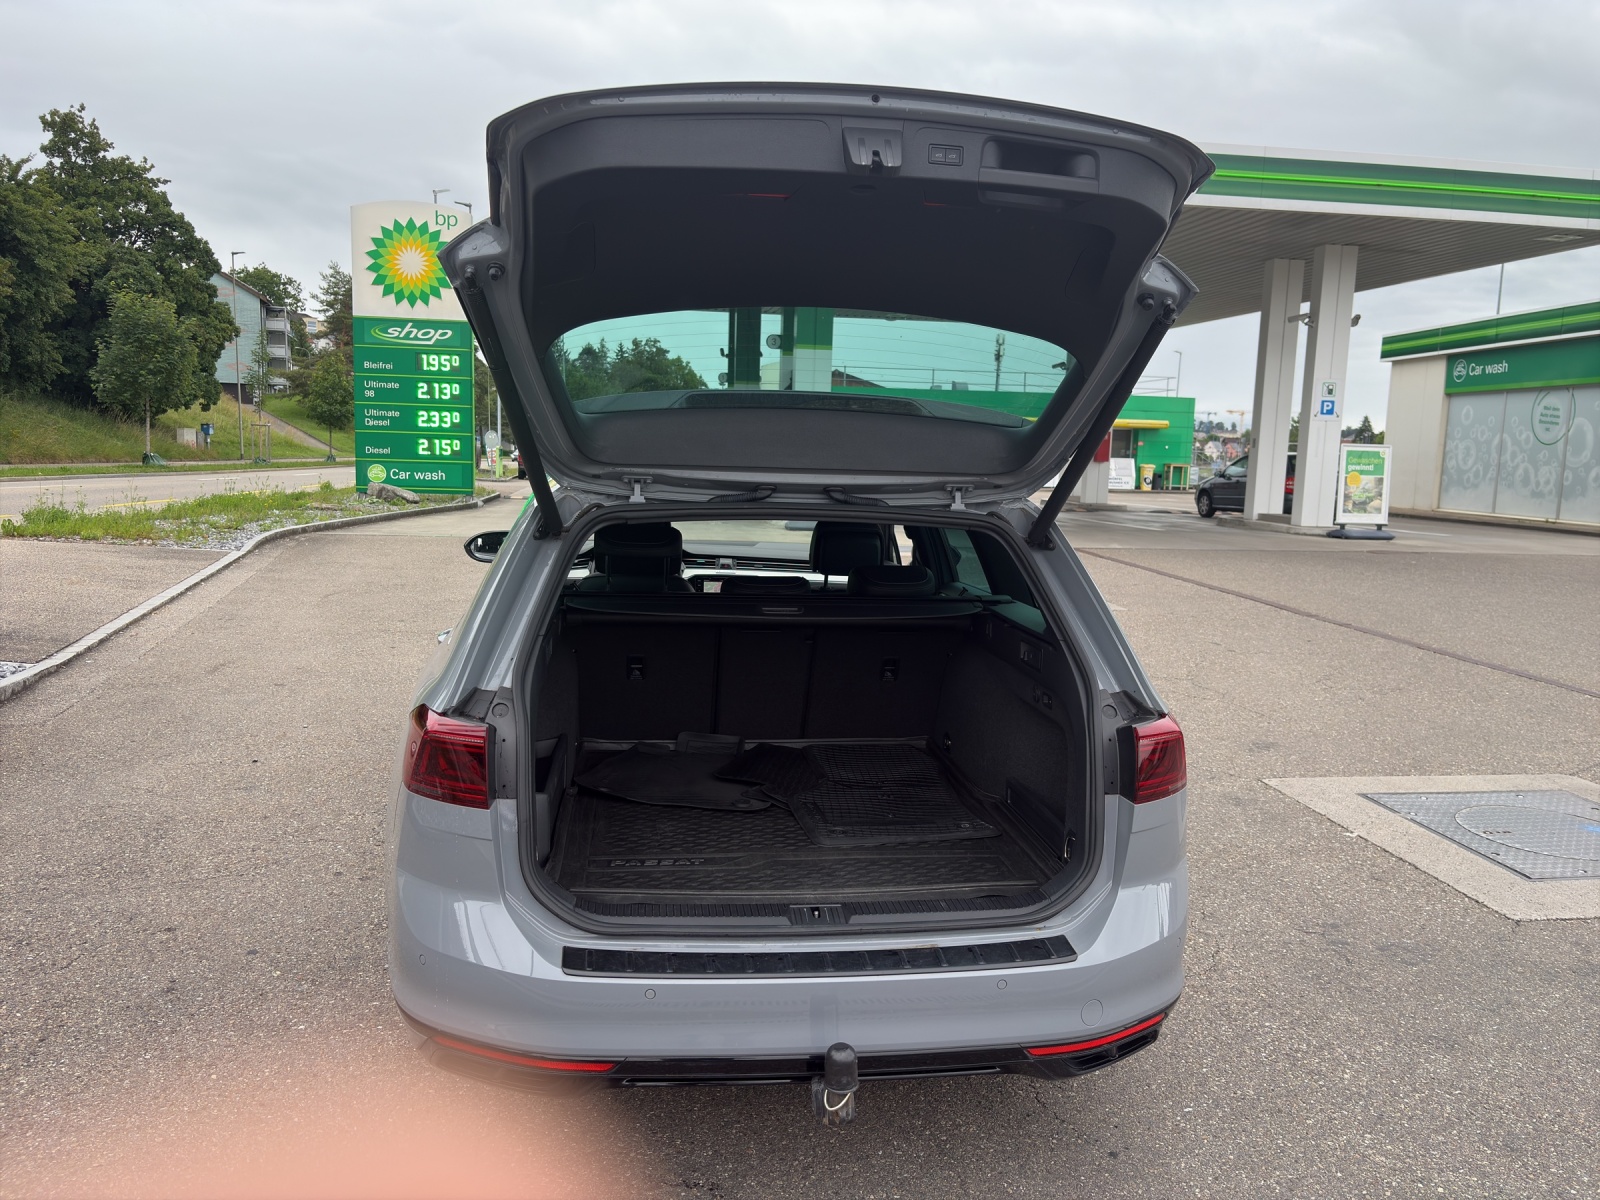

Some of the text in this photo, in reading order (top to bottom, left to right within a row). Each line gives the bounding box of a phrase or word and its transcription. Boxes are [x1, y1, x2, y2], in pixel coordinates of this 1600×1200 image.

[435, 210, 458, 230] bp
[387, 323, 453, 344] shop
[772, 338, 777, 346] 3
[364, 361, 393, 370] Bleifrei
[1469, 360, 1509, 376] Car wash
[364, 380, 400, 389] Ultimate
[364, 390, 375, 398] 98
[1323, 402, 1333, 414] P
[364, 409, 400, 418] Ultimate
[364, 418, 390, 427] Diesel
[365, 446, 391, 455] Diesel
[390, 469, 446, 481] Car wash
[610, 858, 705, 867] PASSAT
